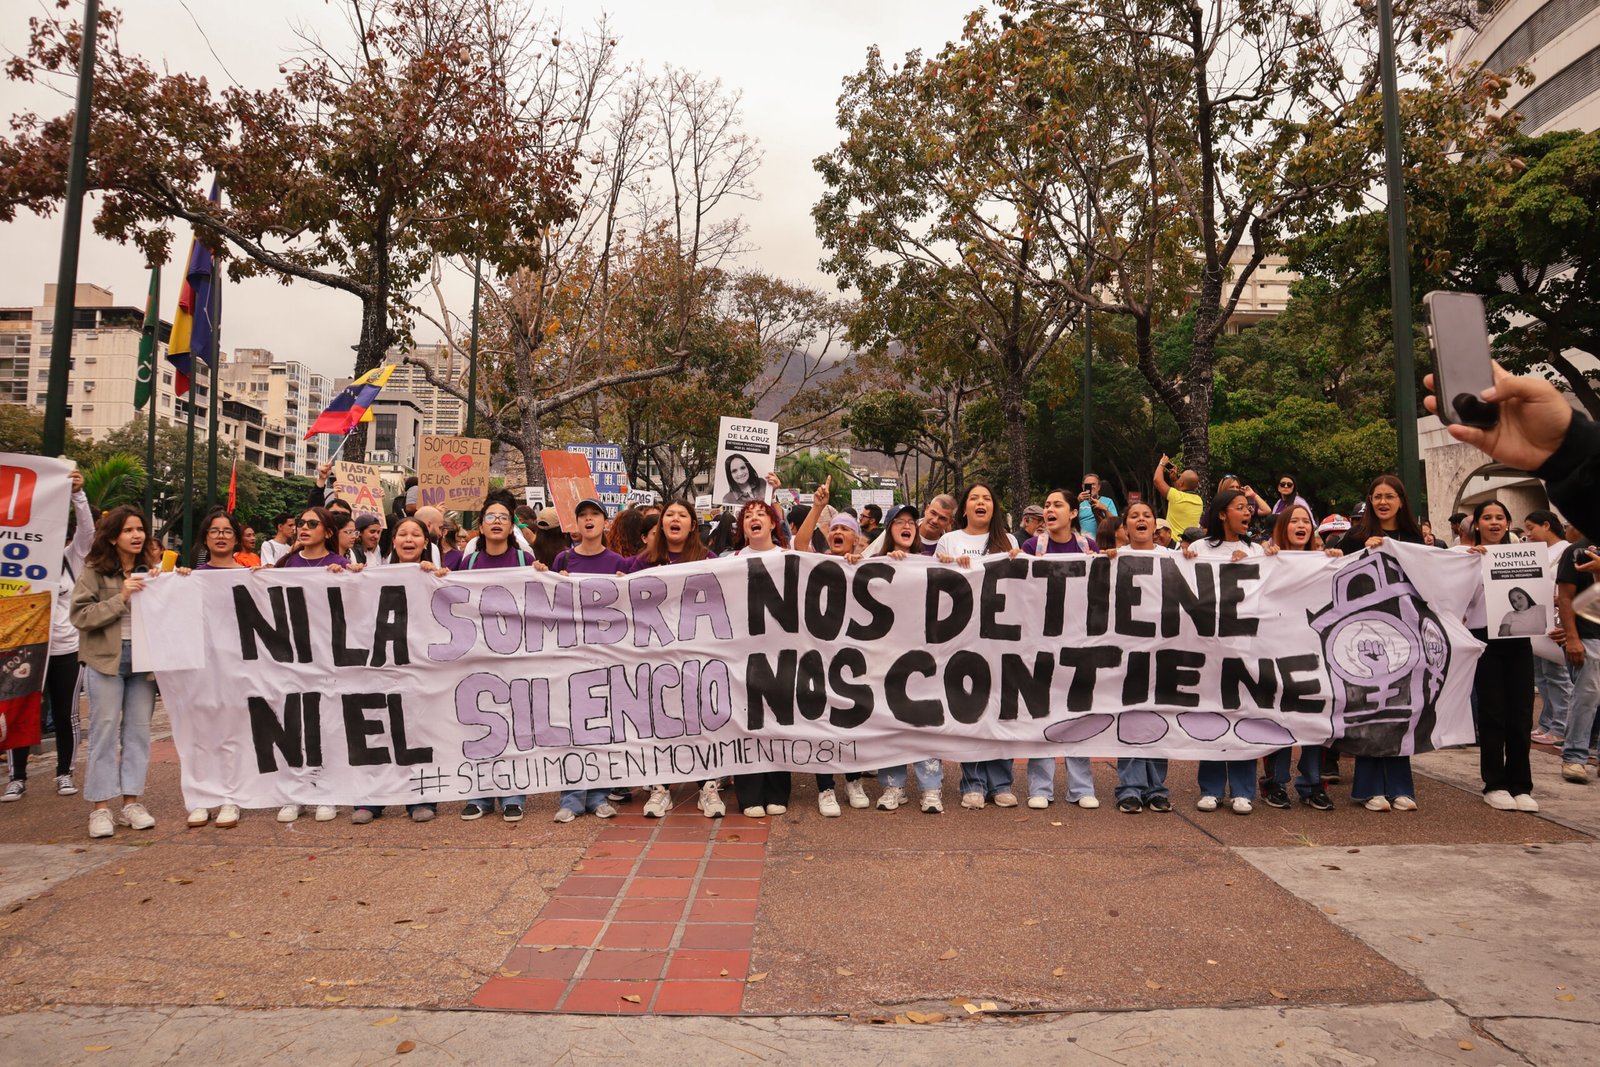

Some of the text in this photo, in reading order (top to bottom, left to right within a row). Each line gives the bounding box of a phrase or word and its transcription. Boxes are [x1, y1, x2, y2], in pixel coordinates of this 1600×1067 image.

[731, 424, 768, 434] GETZABE
[424, 437, 486, 455] SOMOS EL
[341, 463, 375, 476] HASTA
[596, 461, 625, 473] CENTENO
[347, 473, 368, 484] QUE
[420, 473, 486, 487] DE LAS QUE YA
[422, 486, 446, 506] NO
[3, 543, 29, 560] O
[1493, 551, 1536, 559] YUSIMAR
[0, 562, 47, 580] BO
[232, 554, 1260, 667] NI LA SOMBRA NOS DETIENE
[248, 645, 1327, 774] NI EL SILENCIO NOS CONTIENE
